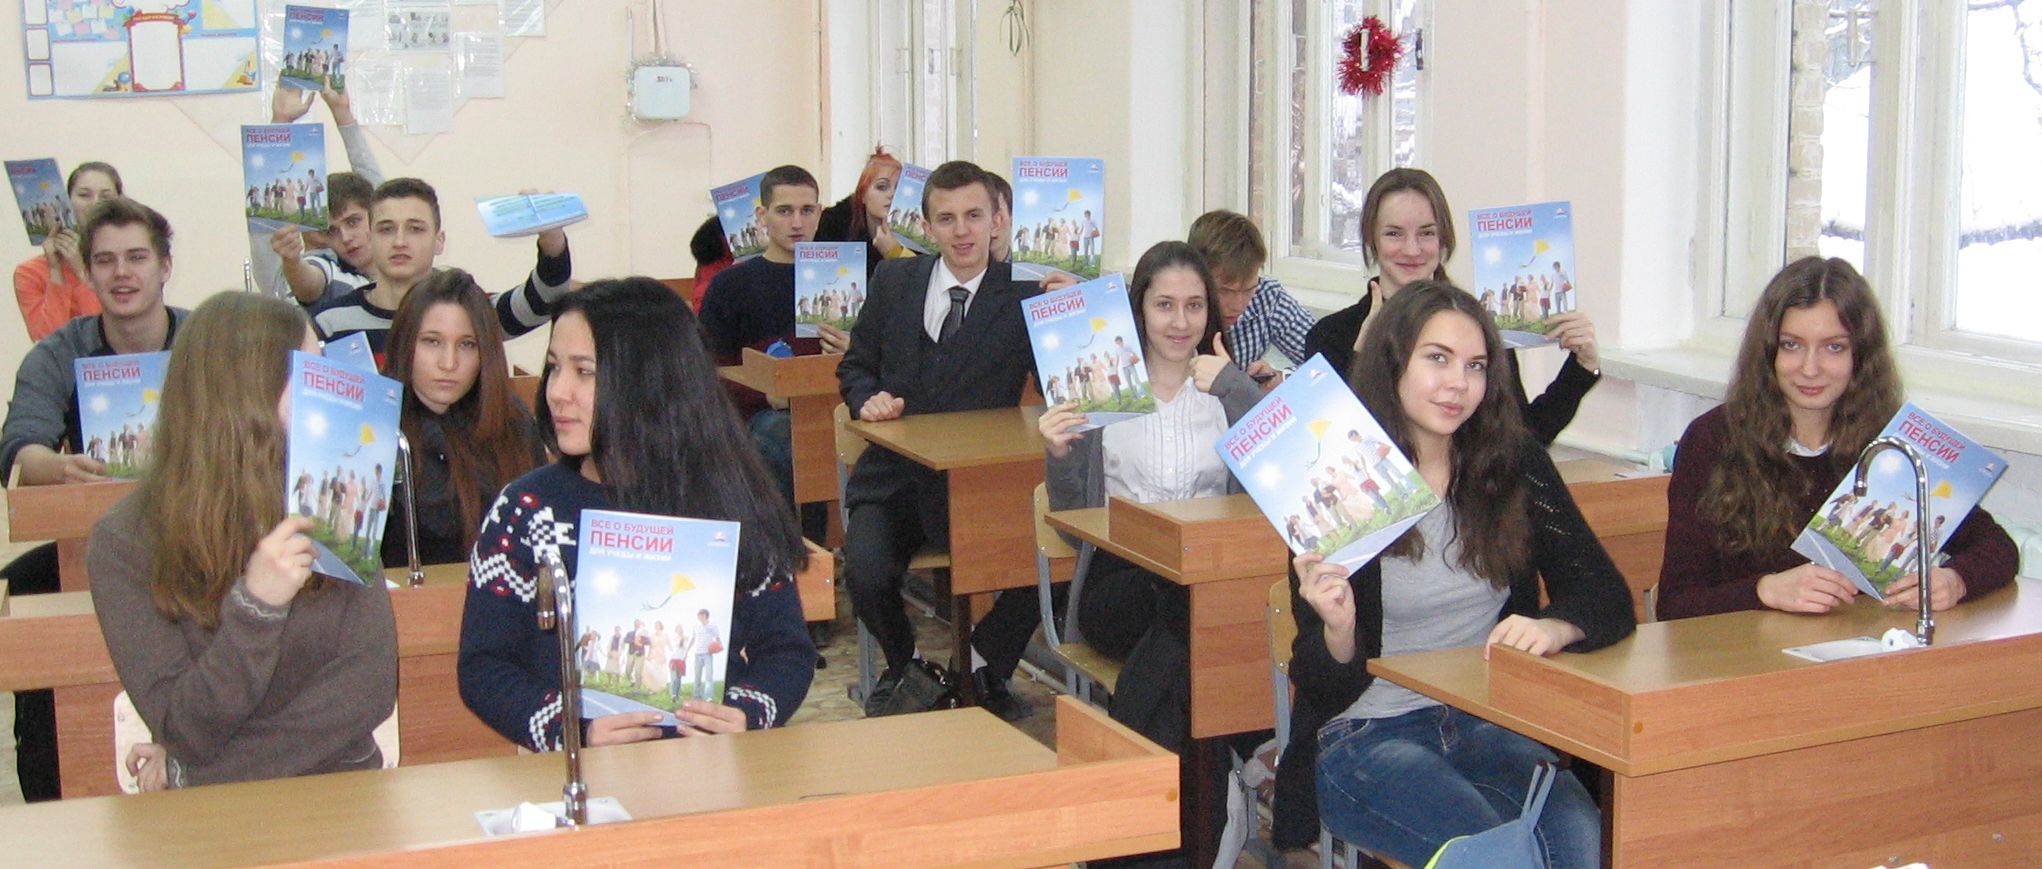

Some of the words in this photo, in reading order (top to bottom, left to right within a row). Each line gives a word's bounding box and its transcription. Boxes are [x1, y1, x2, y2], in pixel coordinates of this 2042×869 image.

[246, 133, 291, 144] ПЕНСИИ
[1019, 167, 1068, 177] ПЕНСИИ
[1477, 217, 1533, 231] ПЕНСИИ
[1031, 296, 1085, 320] ПЕНСИИ
[83, 367, 141, 382] ПЕНСИИ
[304, 371, 365, 402] ПЕНСИИ
[1230, 404, 1292, 461] ПЕНСИИ
[1224, 433, 1240, 449] ВСЕ
[1899, 420, 1961, 463] ПЕНСИИ
[591, 519, 611, 529] ВСЕ
[614, 522, 622, 530] О
[624, 523, 674, 534] БУДУЩЕЙ
[590, 530, 673, 552] ПЕНСИИ
